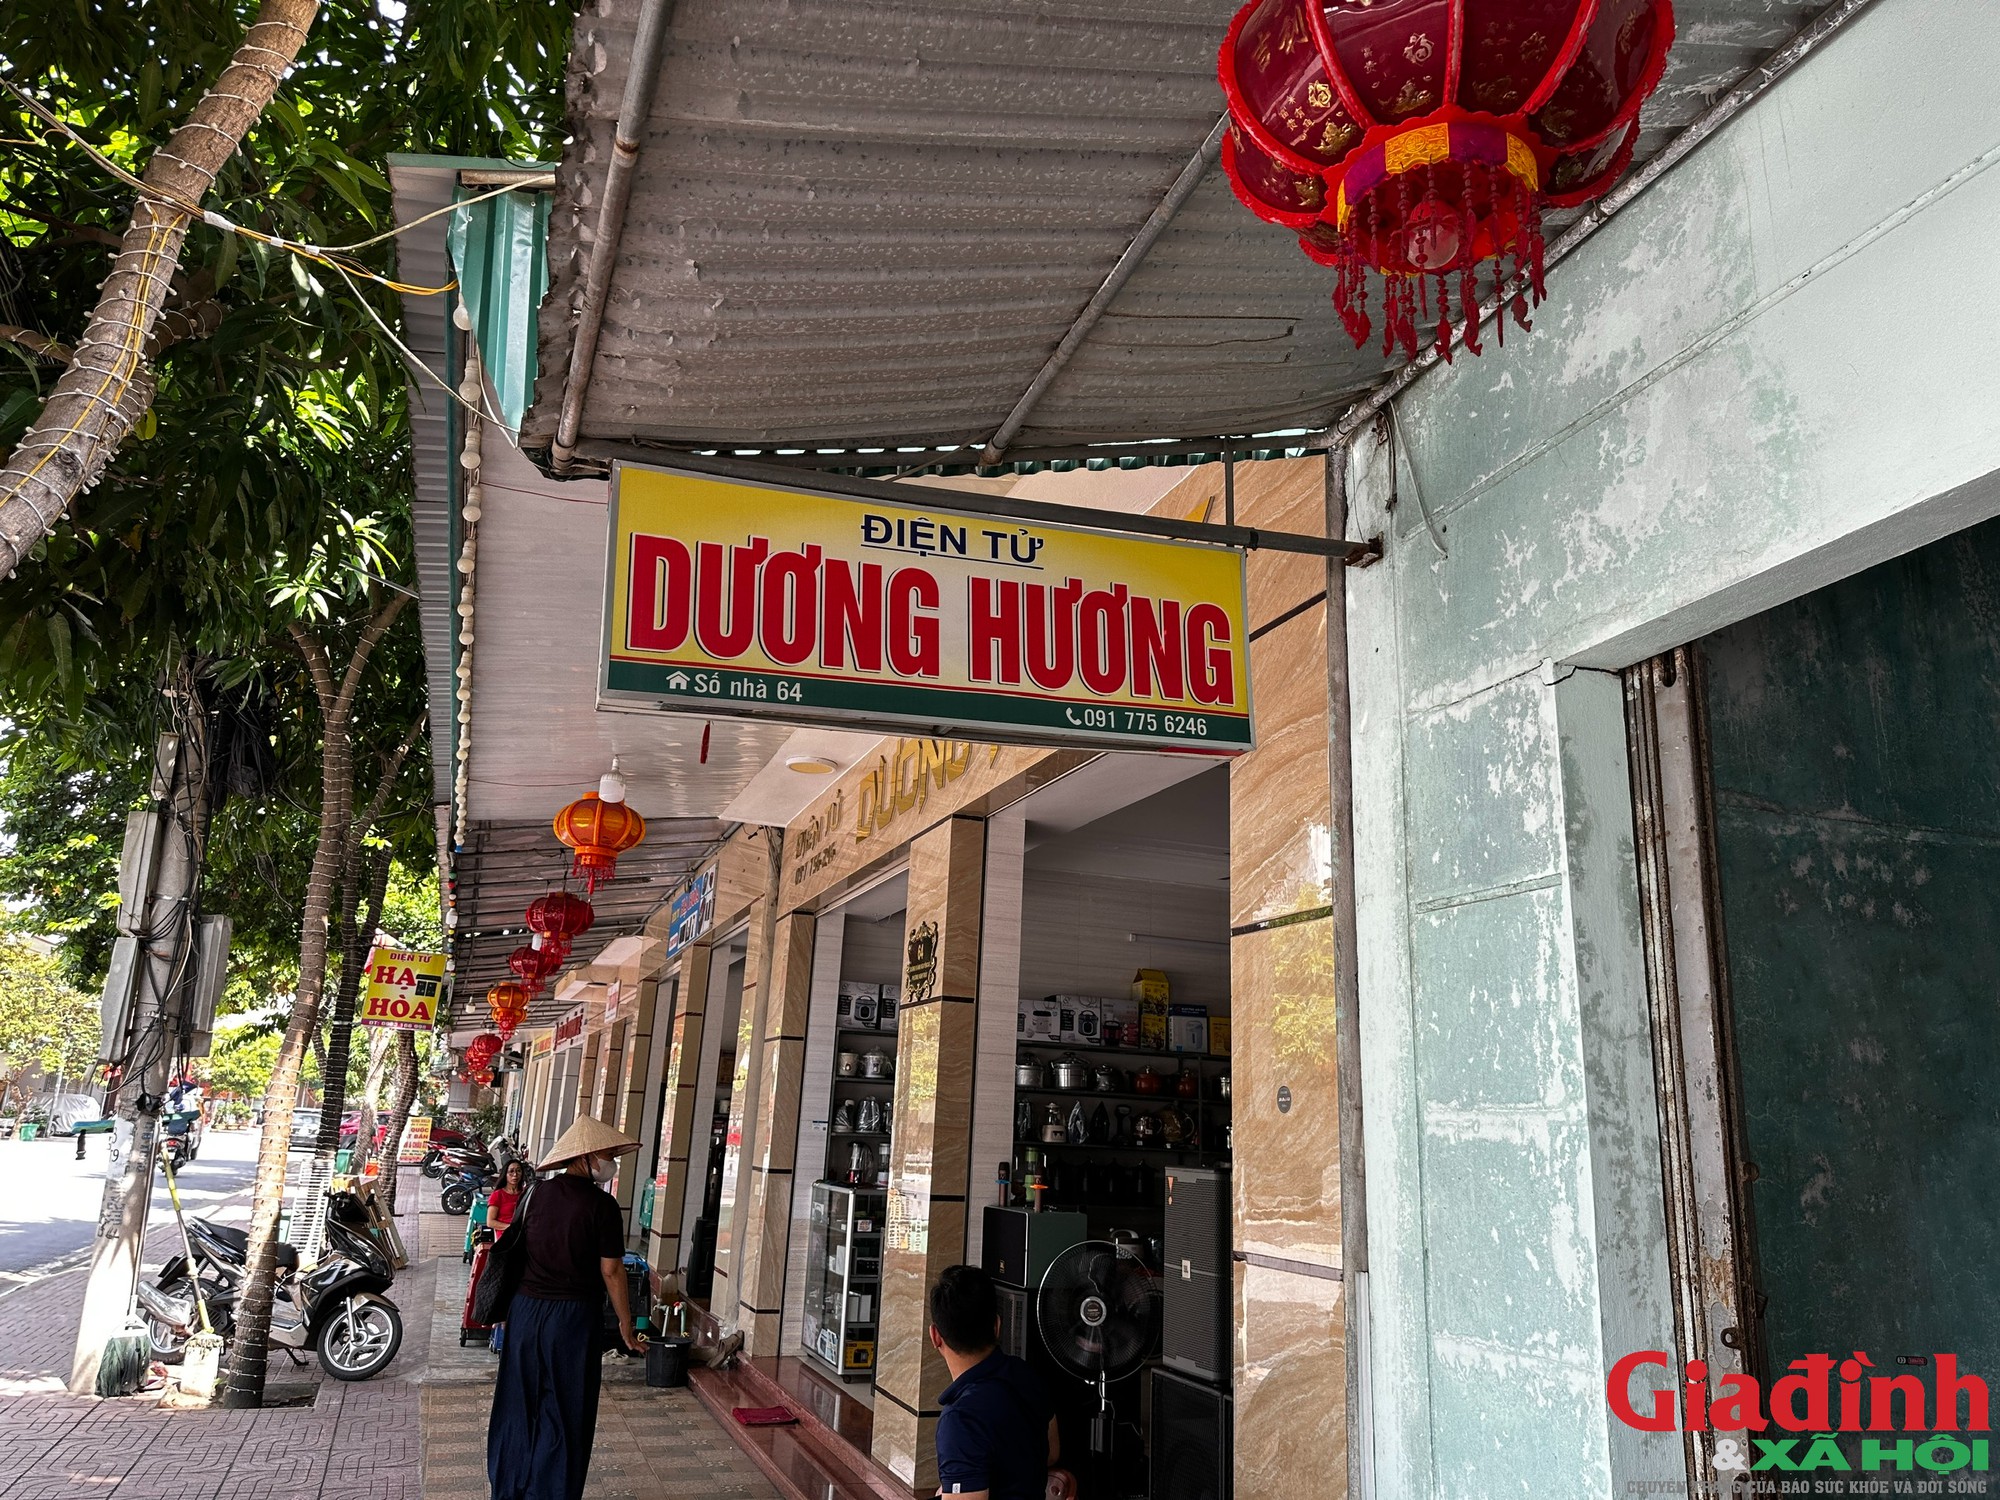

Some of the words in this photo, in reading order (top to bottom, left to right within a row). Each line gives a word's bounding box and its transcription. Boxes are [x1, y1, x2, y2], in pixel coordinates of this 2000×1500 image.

[861, 514, 967, 557] ĐIỆN
[982, 528, 1045, 563] TỬ
[626, 532, 940, 678] DƯƠNG
[967, 575, 1235, 706] HƯƠNG
[694, 672, 721, 694] Số
[730, 678, 767, 699] nhà
[777, 681, 803, 702] 64
[1084, 709, 1115, 729] 091
[1124, 712, 1157, 732] 775
[1164, 715, 1207, 736] 6246
[374, 966, 417, 990] HẠ
[367, 994, 431, 1021] HÒA
